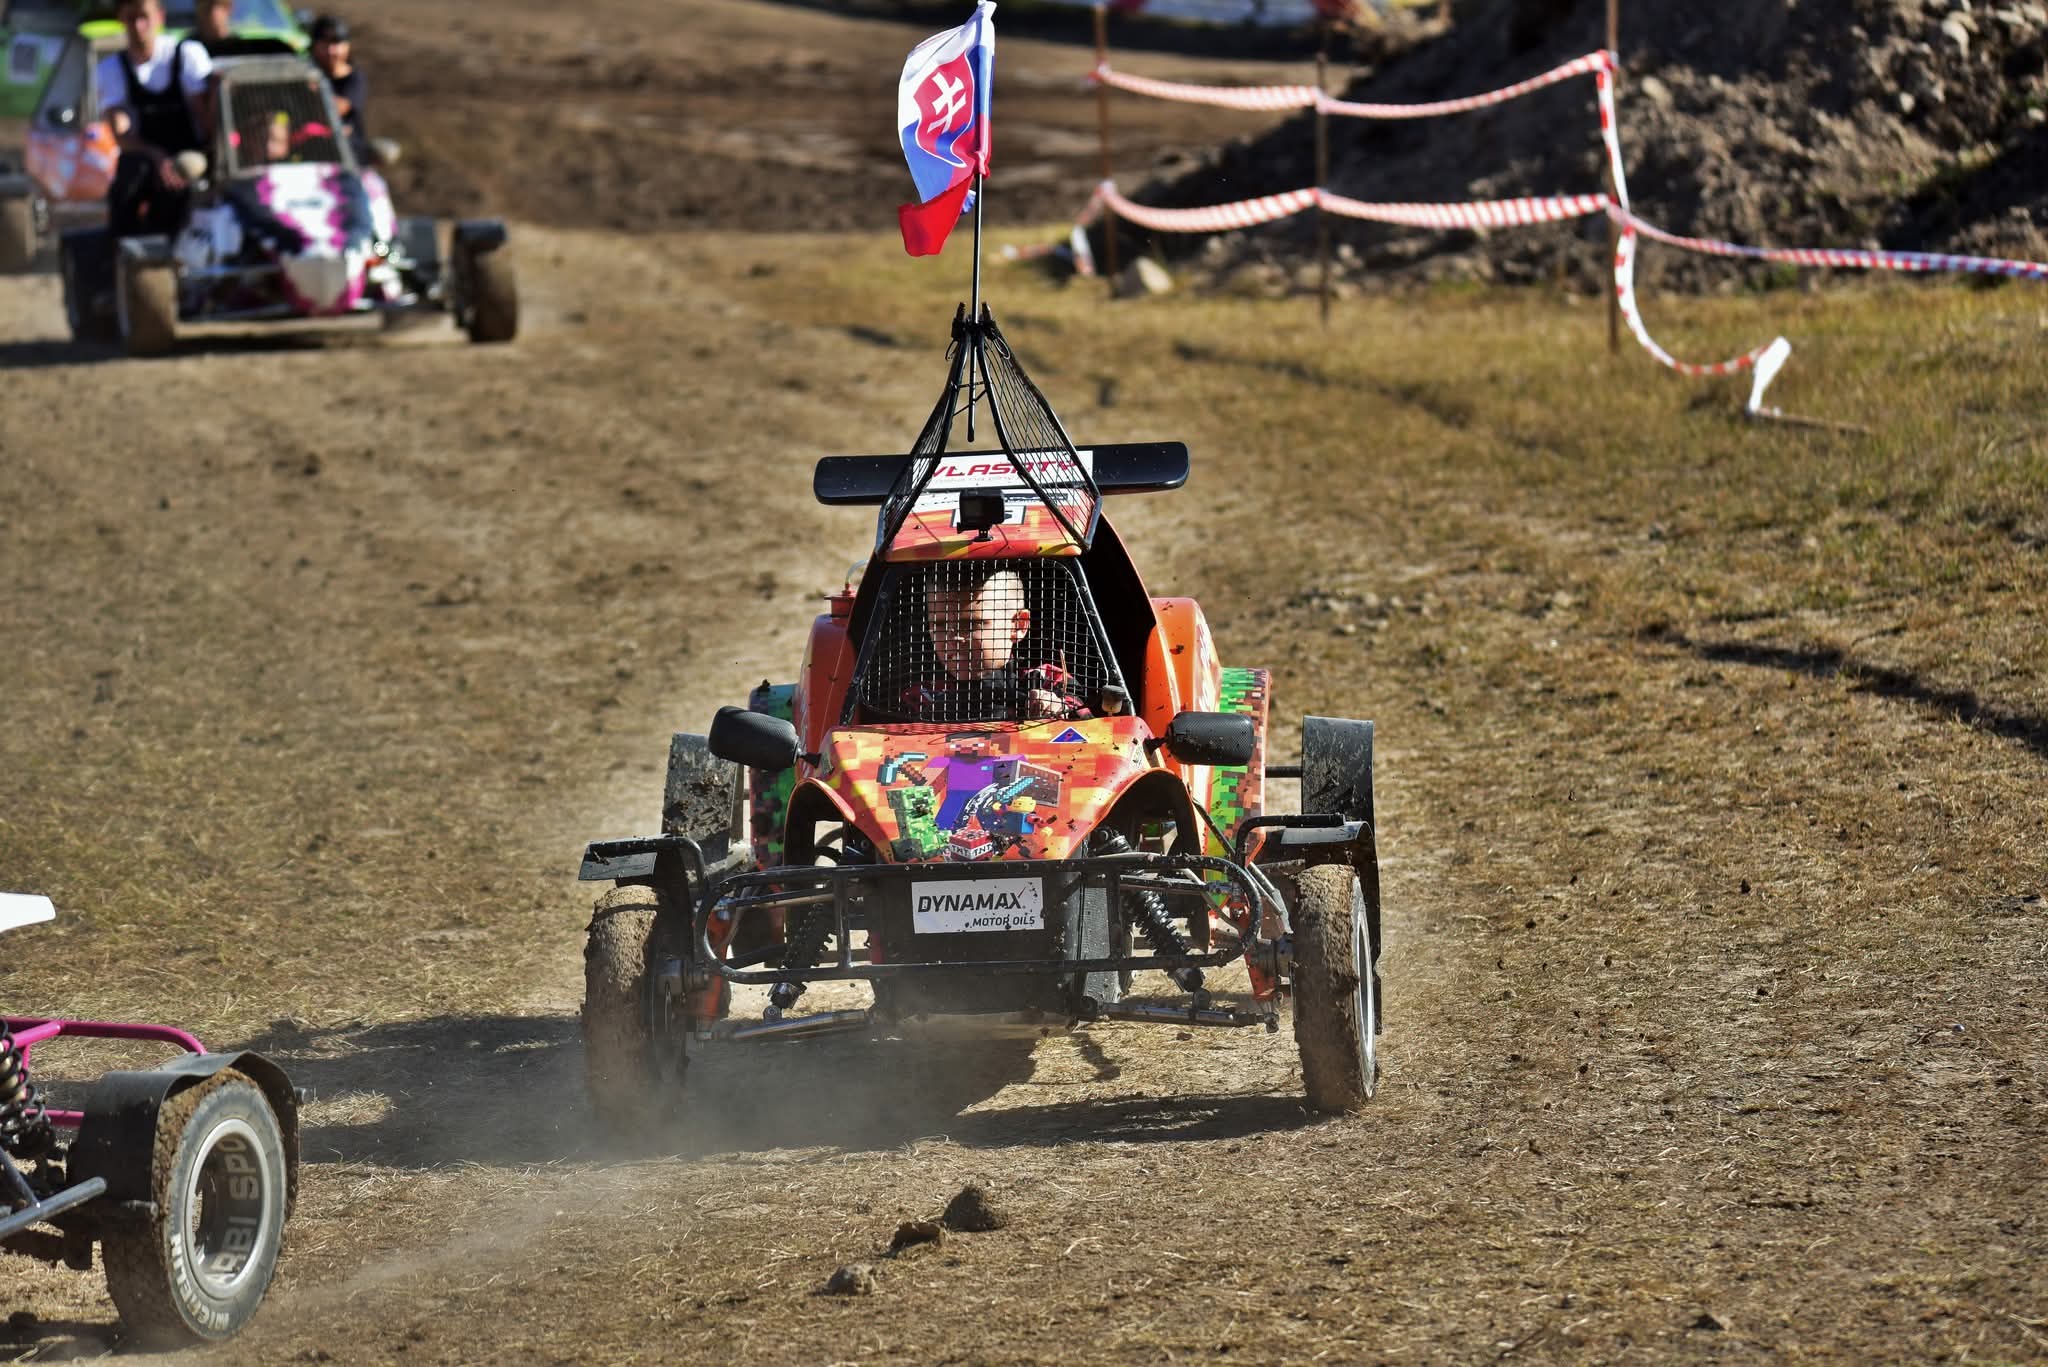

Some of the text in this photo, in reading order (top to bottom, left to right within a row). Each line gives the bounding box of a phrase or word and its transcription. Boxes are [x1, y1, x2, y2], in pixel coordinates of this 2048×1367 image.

[974, 843, 993, 856] TNT
[918, 893, 1022, 913] DYNAMAX
[972, 916, 1035, 927] MOTOR OILS
